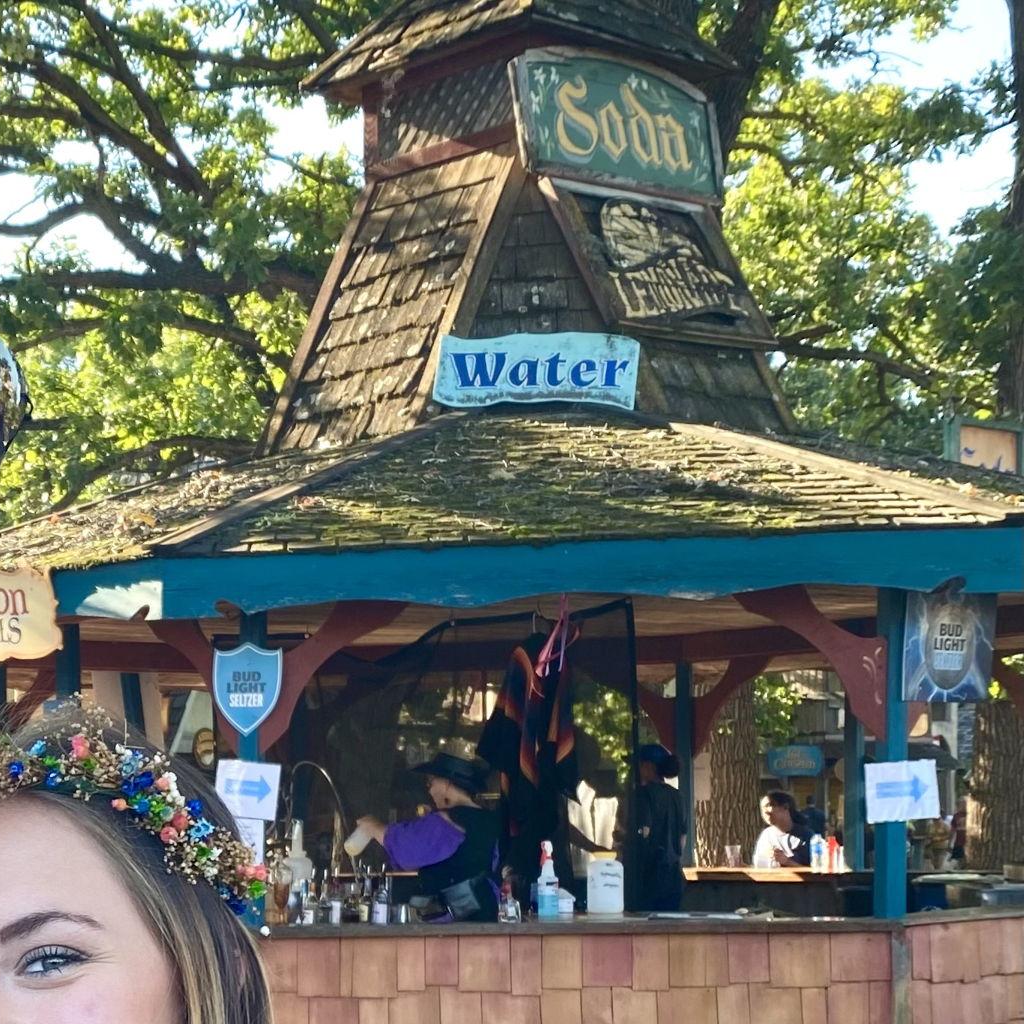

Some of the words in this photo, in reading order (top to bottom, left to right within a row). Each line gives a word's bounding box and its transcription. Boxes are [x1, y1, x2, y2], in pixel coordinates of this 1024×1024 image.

[556, 75, 693, 171] Soda
[449, 351, 630, 389] Water
[940, 623, 963, 637] BUD
[933, 638, 967, 651] LIGHT
[232, 671, 262, 682] BUD
[226, 682, 267, 693] LIGHT
[229, 693, 264, 708] SELTZER
